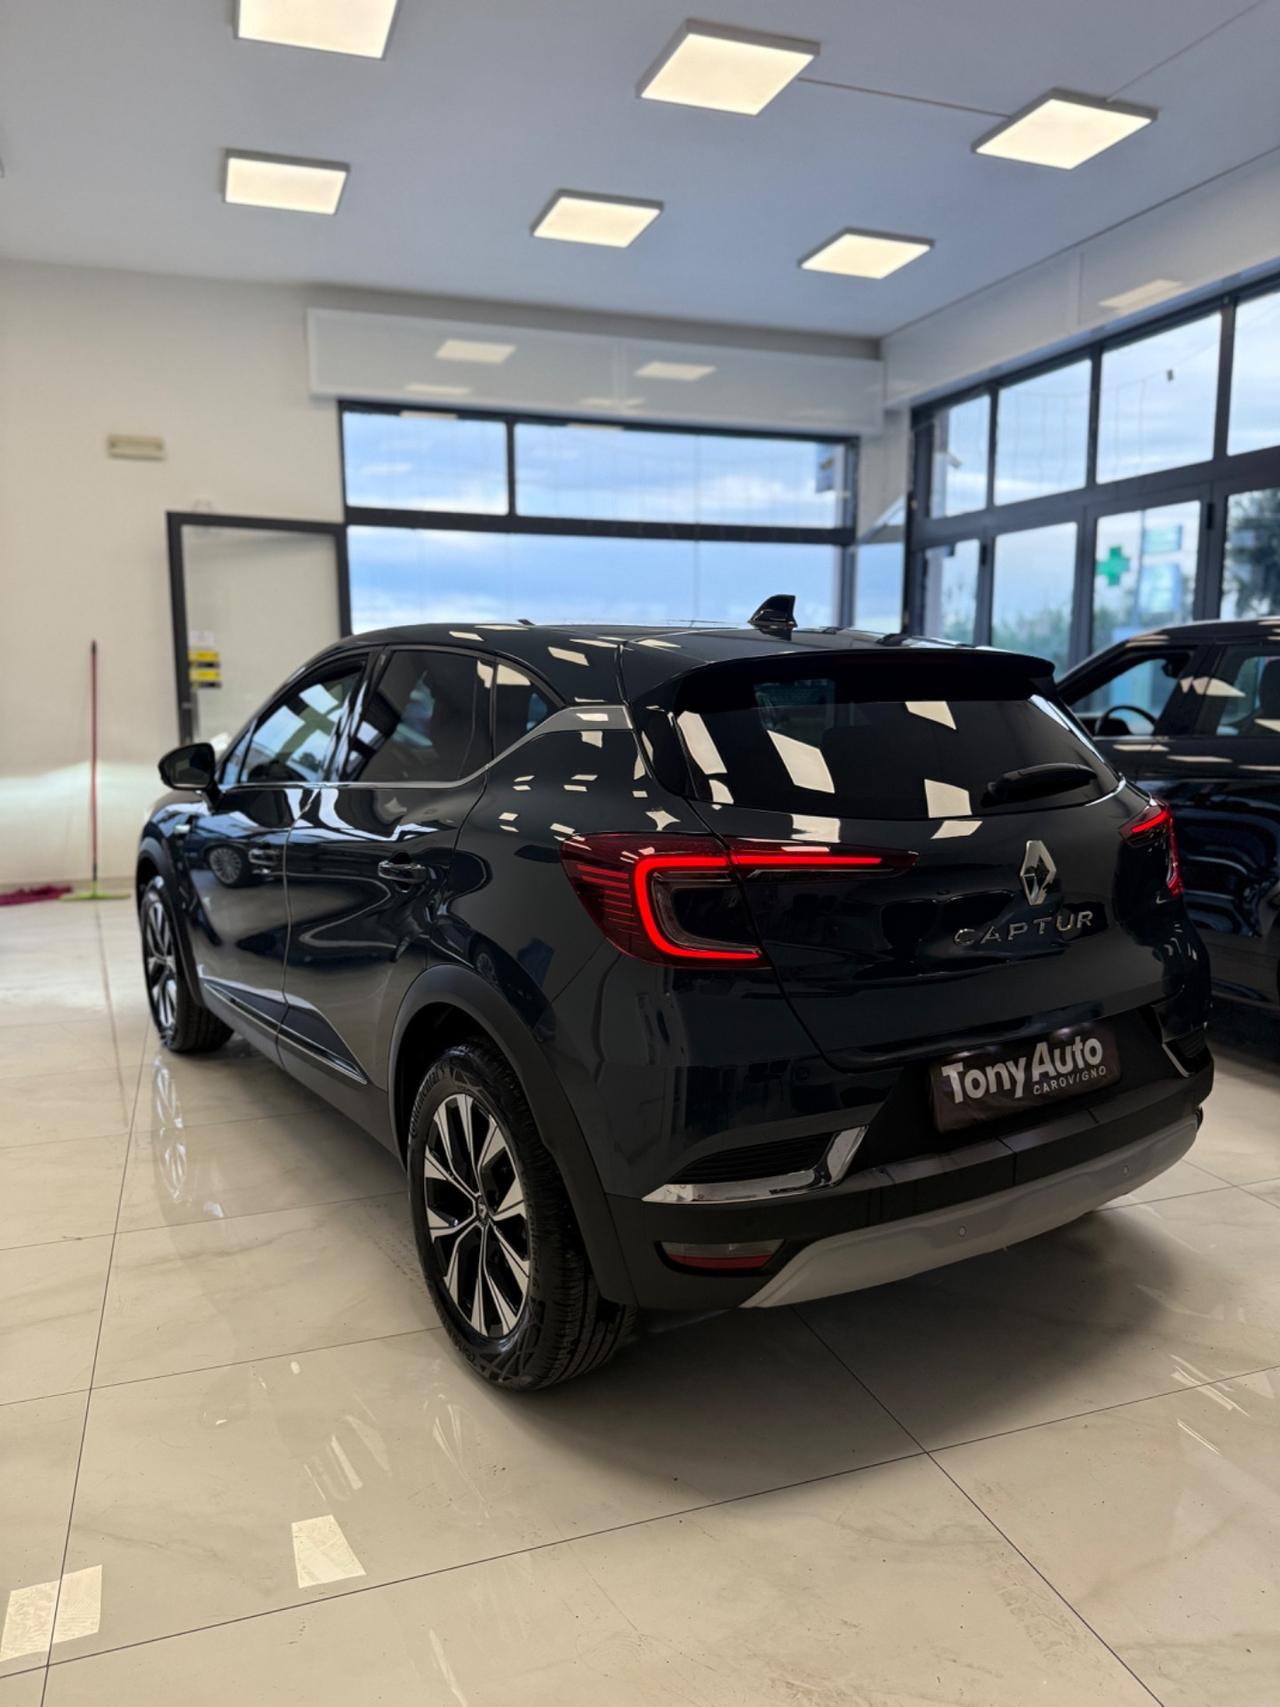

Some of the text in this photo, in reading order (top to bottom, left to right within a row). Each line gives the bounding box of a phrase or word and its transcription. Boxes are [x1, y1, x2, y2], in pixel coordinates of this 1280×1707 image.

[954, 910, 1094, 945] CAPTUR
[941, 1036, 1104, 1103] Tony Auto
[1033, 1066, 1107, 1095] CAROVIGNO
